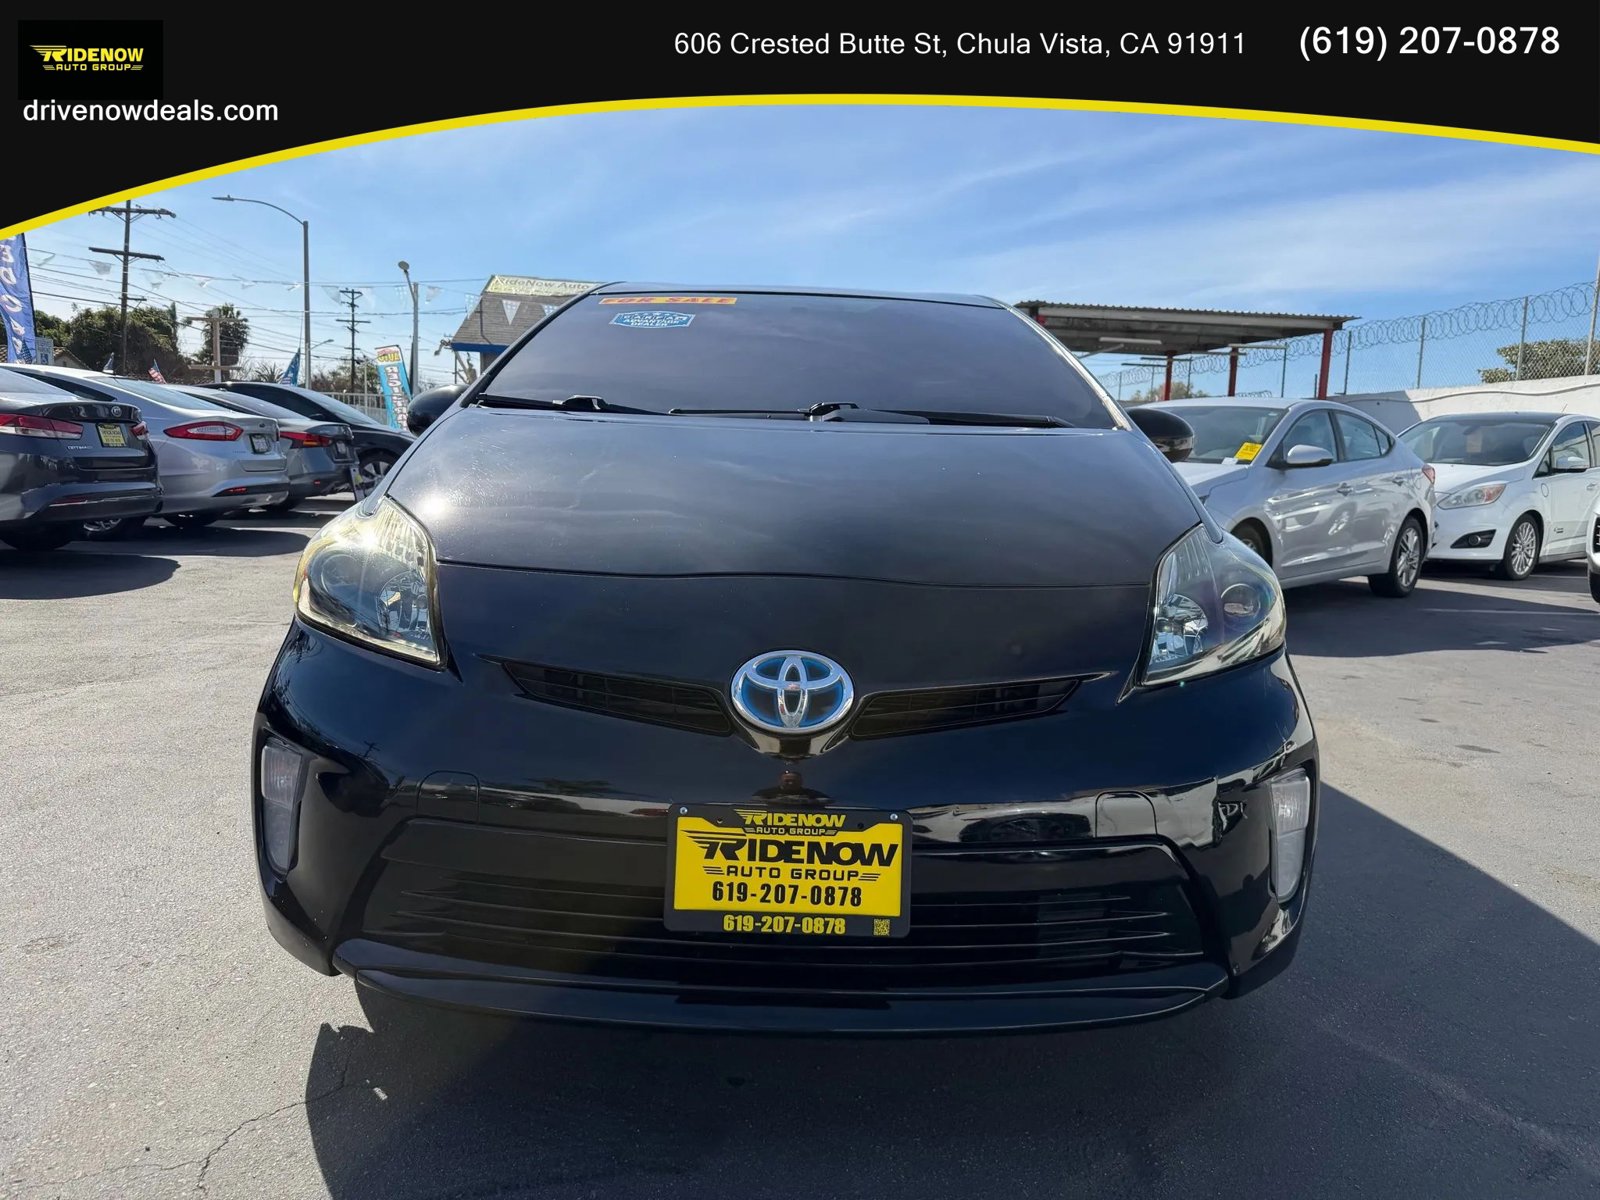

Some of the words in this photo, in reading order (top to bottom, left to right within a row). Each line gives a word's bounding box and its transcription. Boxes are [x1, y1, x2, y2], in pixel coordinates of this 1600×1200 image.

[495, 277, 554, 289] RideNow
[557, 282, 591, 290] Auto
[734, 809, 846, 828] RIDENOW
[756, 827, 785, 835] AUTO
[789, 828, 826, 836] GROUP
[682, 830, 899, 867] RIDENOW
[726, 865, 781, 879] AUTO
[790, 868, 860, 881] GROUP
[712, 880, 863, 907] 619-207-0878
[723, 914, 846, 935] 619-207-0878
